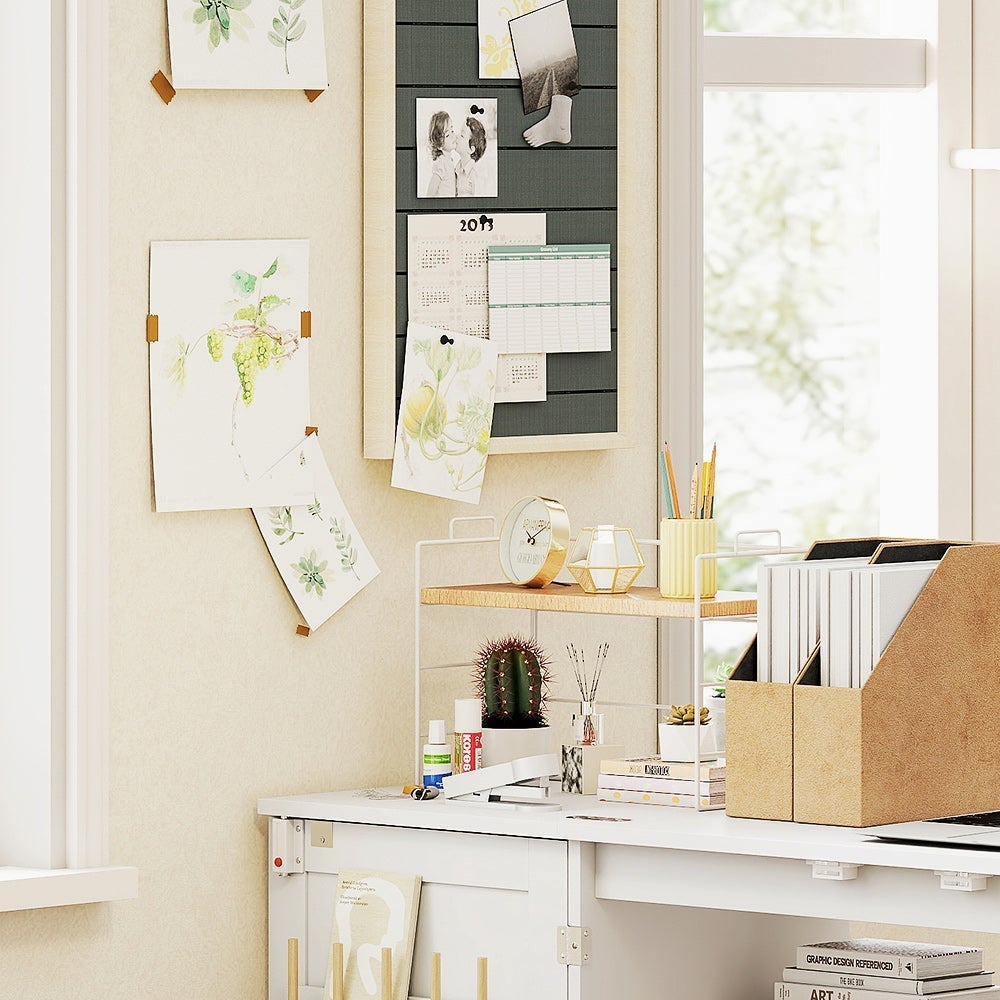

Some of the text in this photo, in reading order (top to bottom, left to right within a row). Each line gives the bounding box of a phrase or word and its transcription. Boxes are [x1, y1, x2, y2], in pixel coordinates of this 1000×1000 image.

[806, 954, 832, 966] GRAPHIC
[833, 956, 854, 968] DESIGN
[855, 958, 893, 971] REFERENCED
